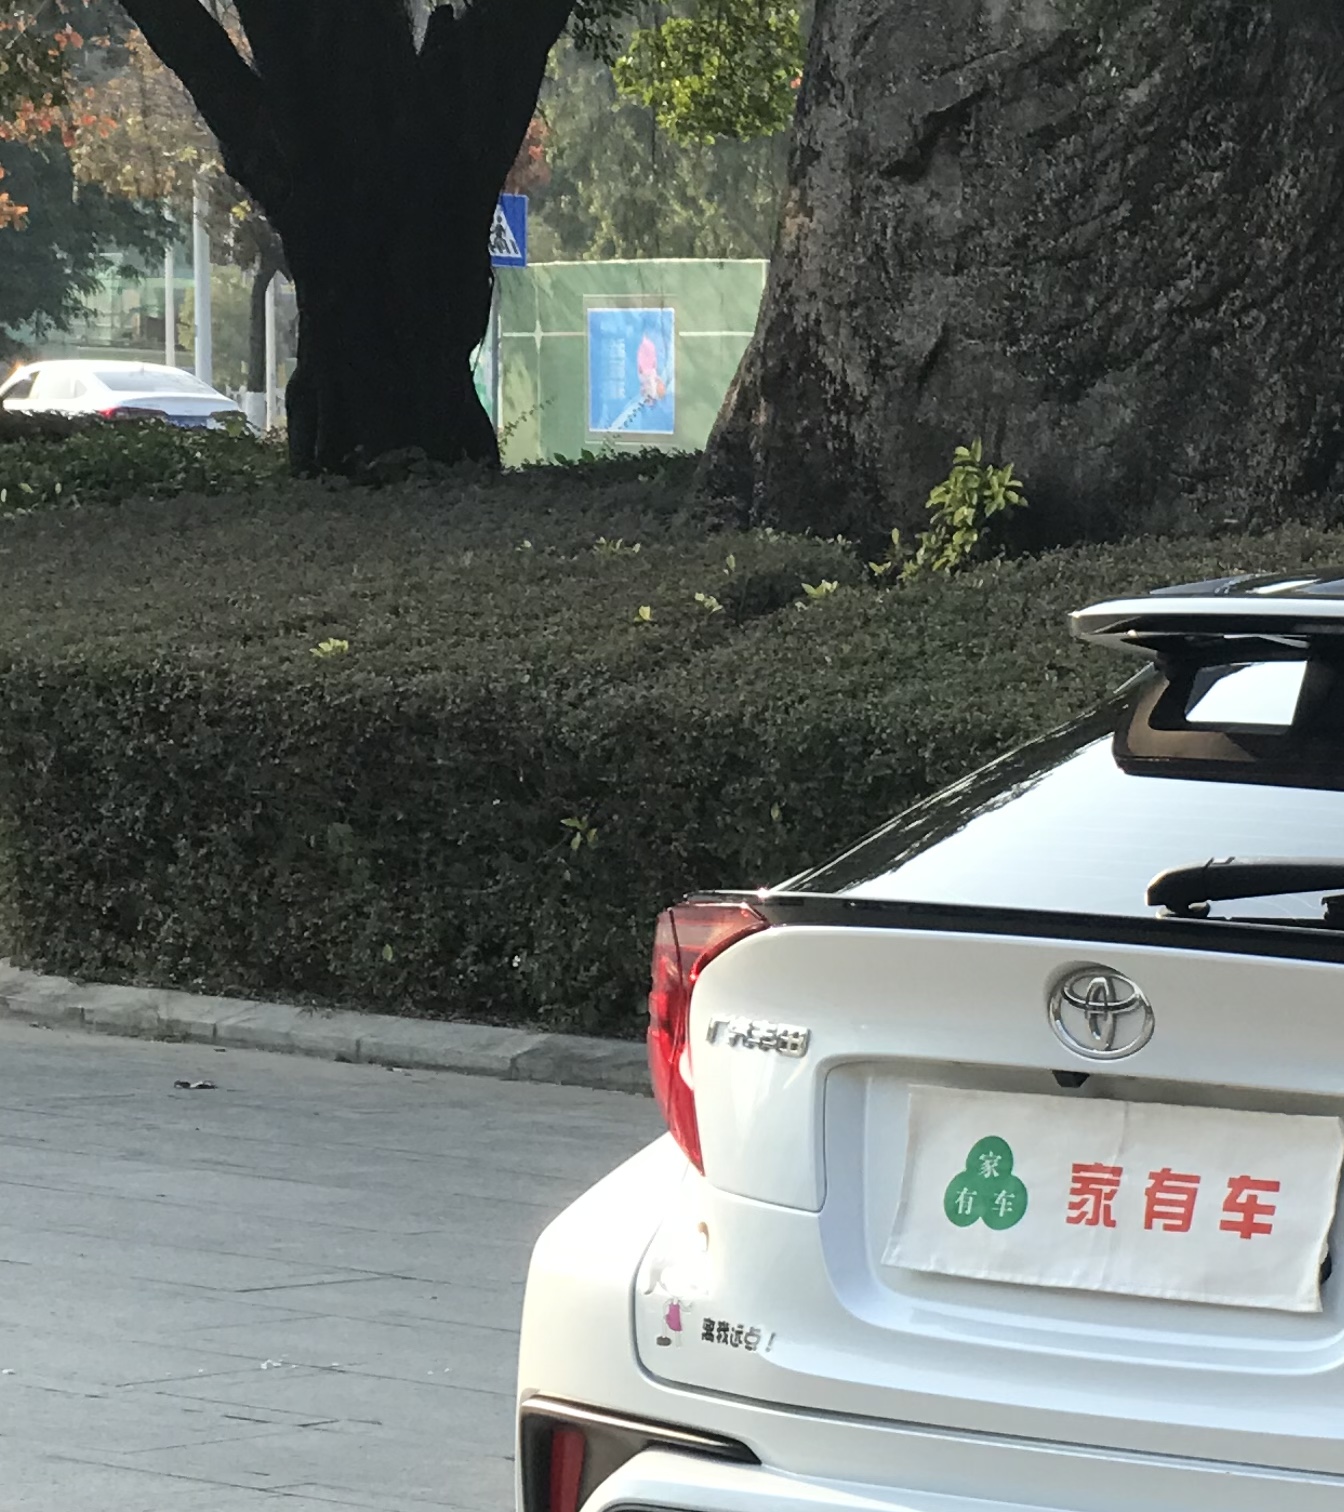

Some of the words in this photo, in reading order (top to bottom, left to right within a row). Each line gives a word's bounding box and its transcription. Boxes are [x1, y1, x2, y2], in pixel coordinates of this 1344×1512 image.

[979, 1150, 1002, 1178] 家
[1066, 1162, 1281, 1240] 家有车
